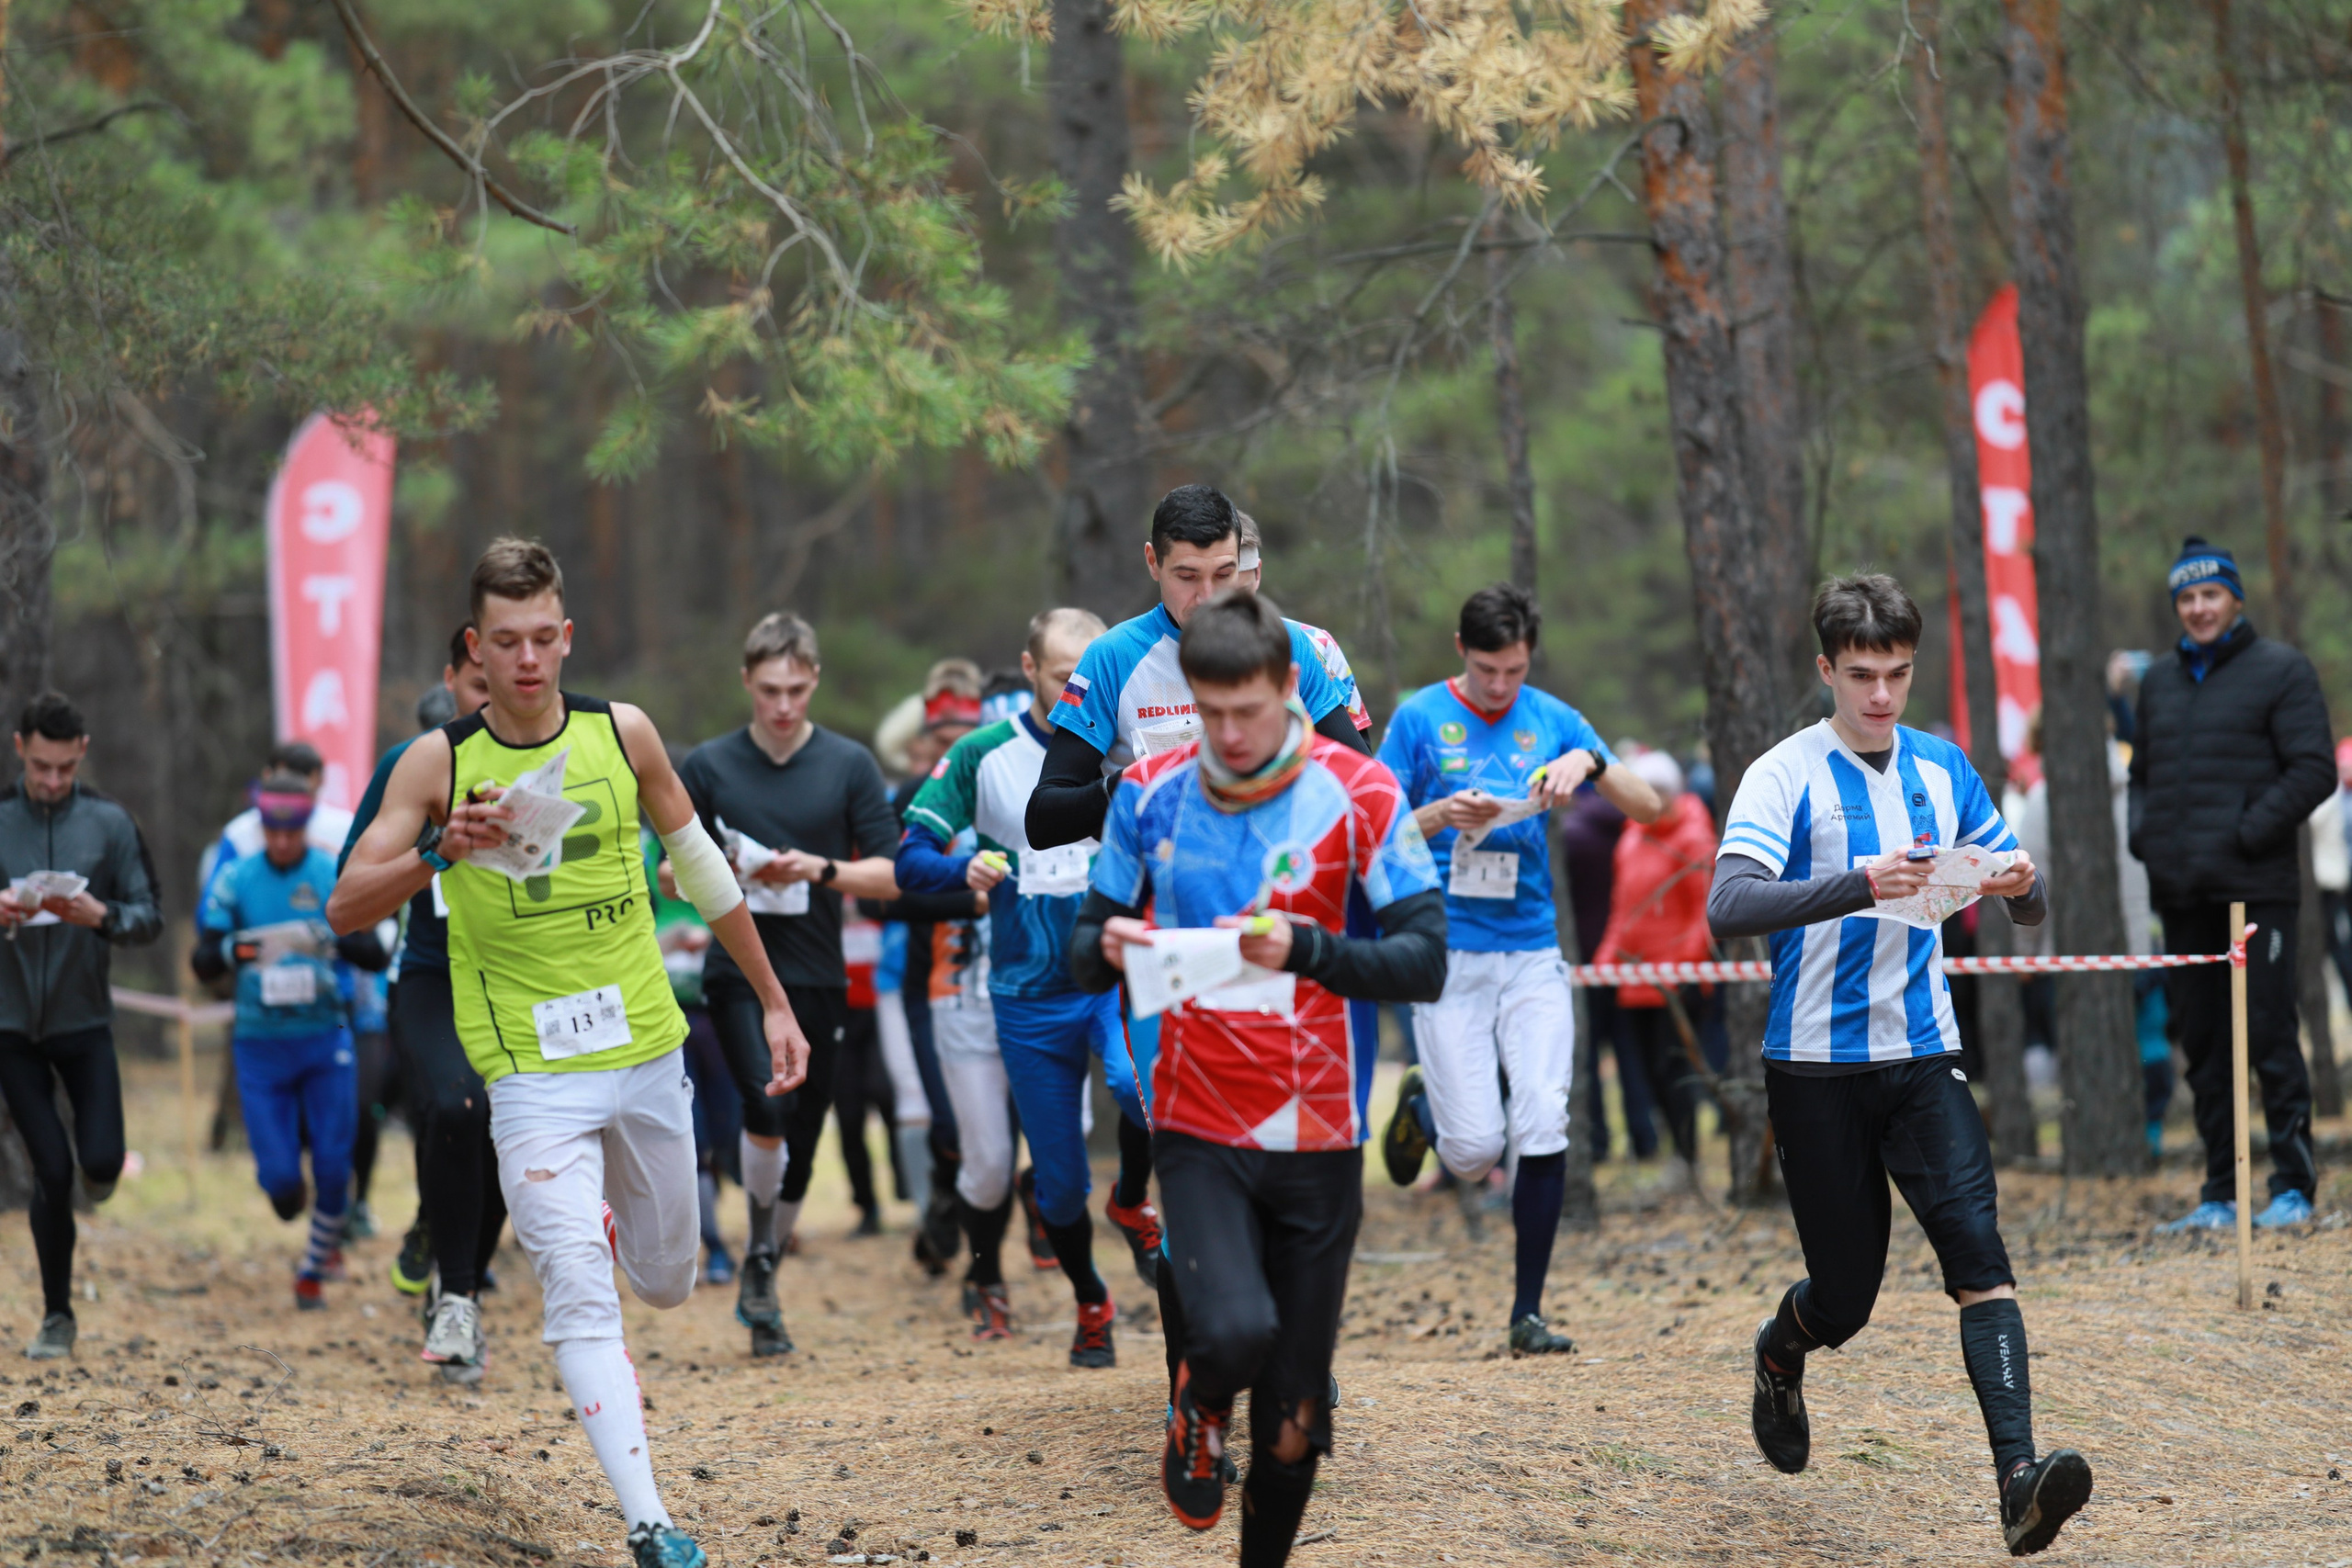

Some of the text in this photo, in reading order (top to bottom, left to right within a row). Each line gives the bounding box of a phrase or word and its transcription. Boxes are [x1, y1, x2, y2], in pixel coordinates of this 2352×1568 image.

[1137, 703, 1199, 718] REDLINE
[1830, 813, 1871, 822] Артемий
[571, 1013, 594, 1033] 13
